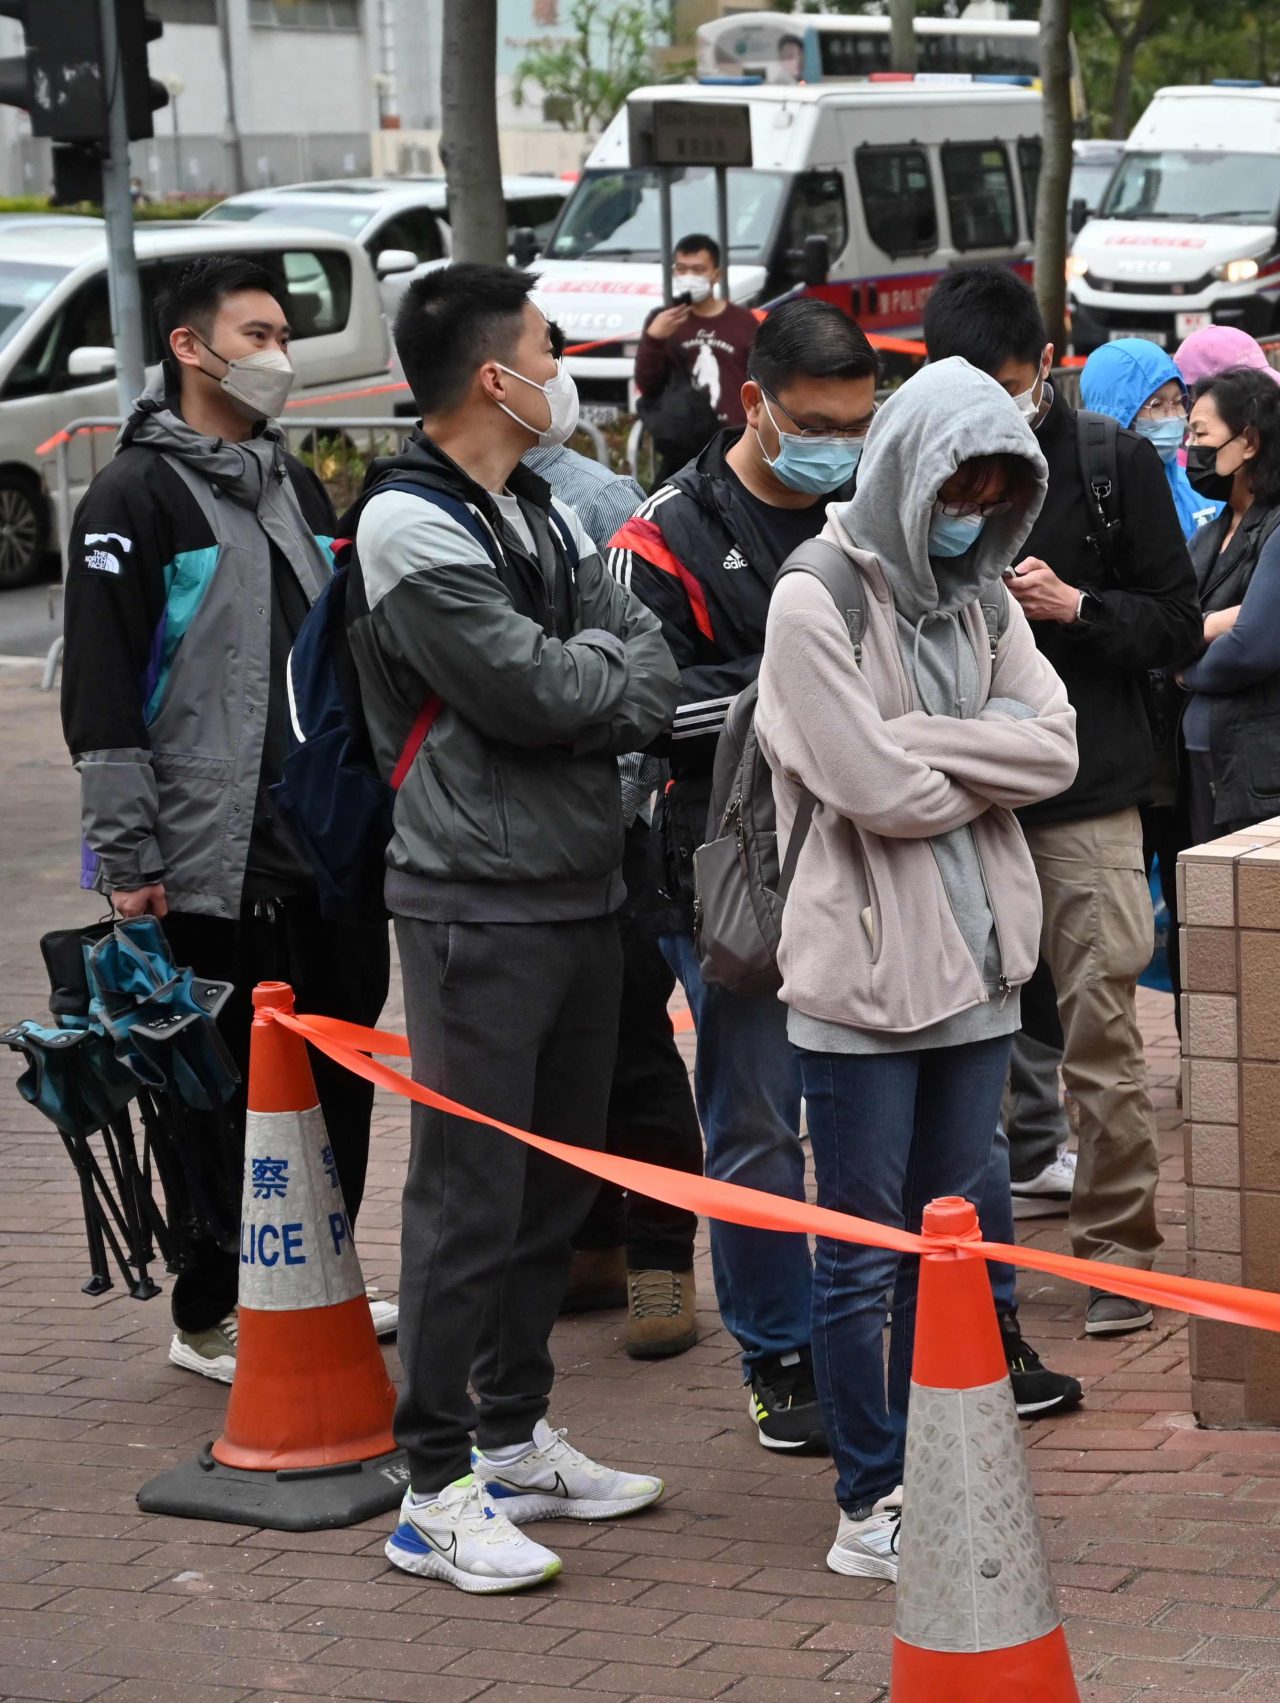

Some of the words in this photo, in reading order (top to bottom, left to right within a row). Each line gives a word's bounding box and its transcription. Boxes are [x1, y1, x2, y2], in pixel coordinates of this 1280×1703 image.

[558, 312, 623, 330] IVECO
[93, 549, 108, 558] THE
[85, 555, 106, 565] NORTH
[87, 561, 106, 570] FACE
[252, 1156, 289, 1199] 察
